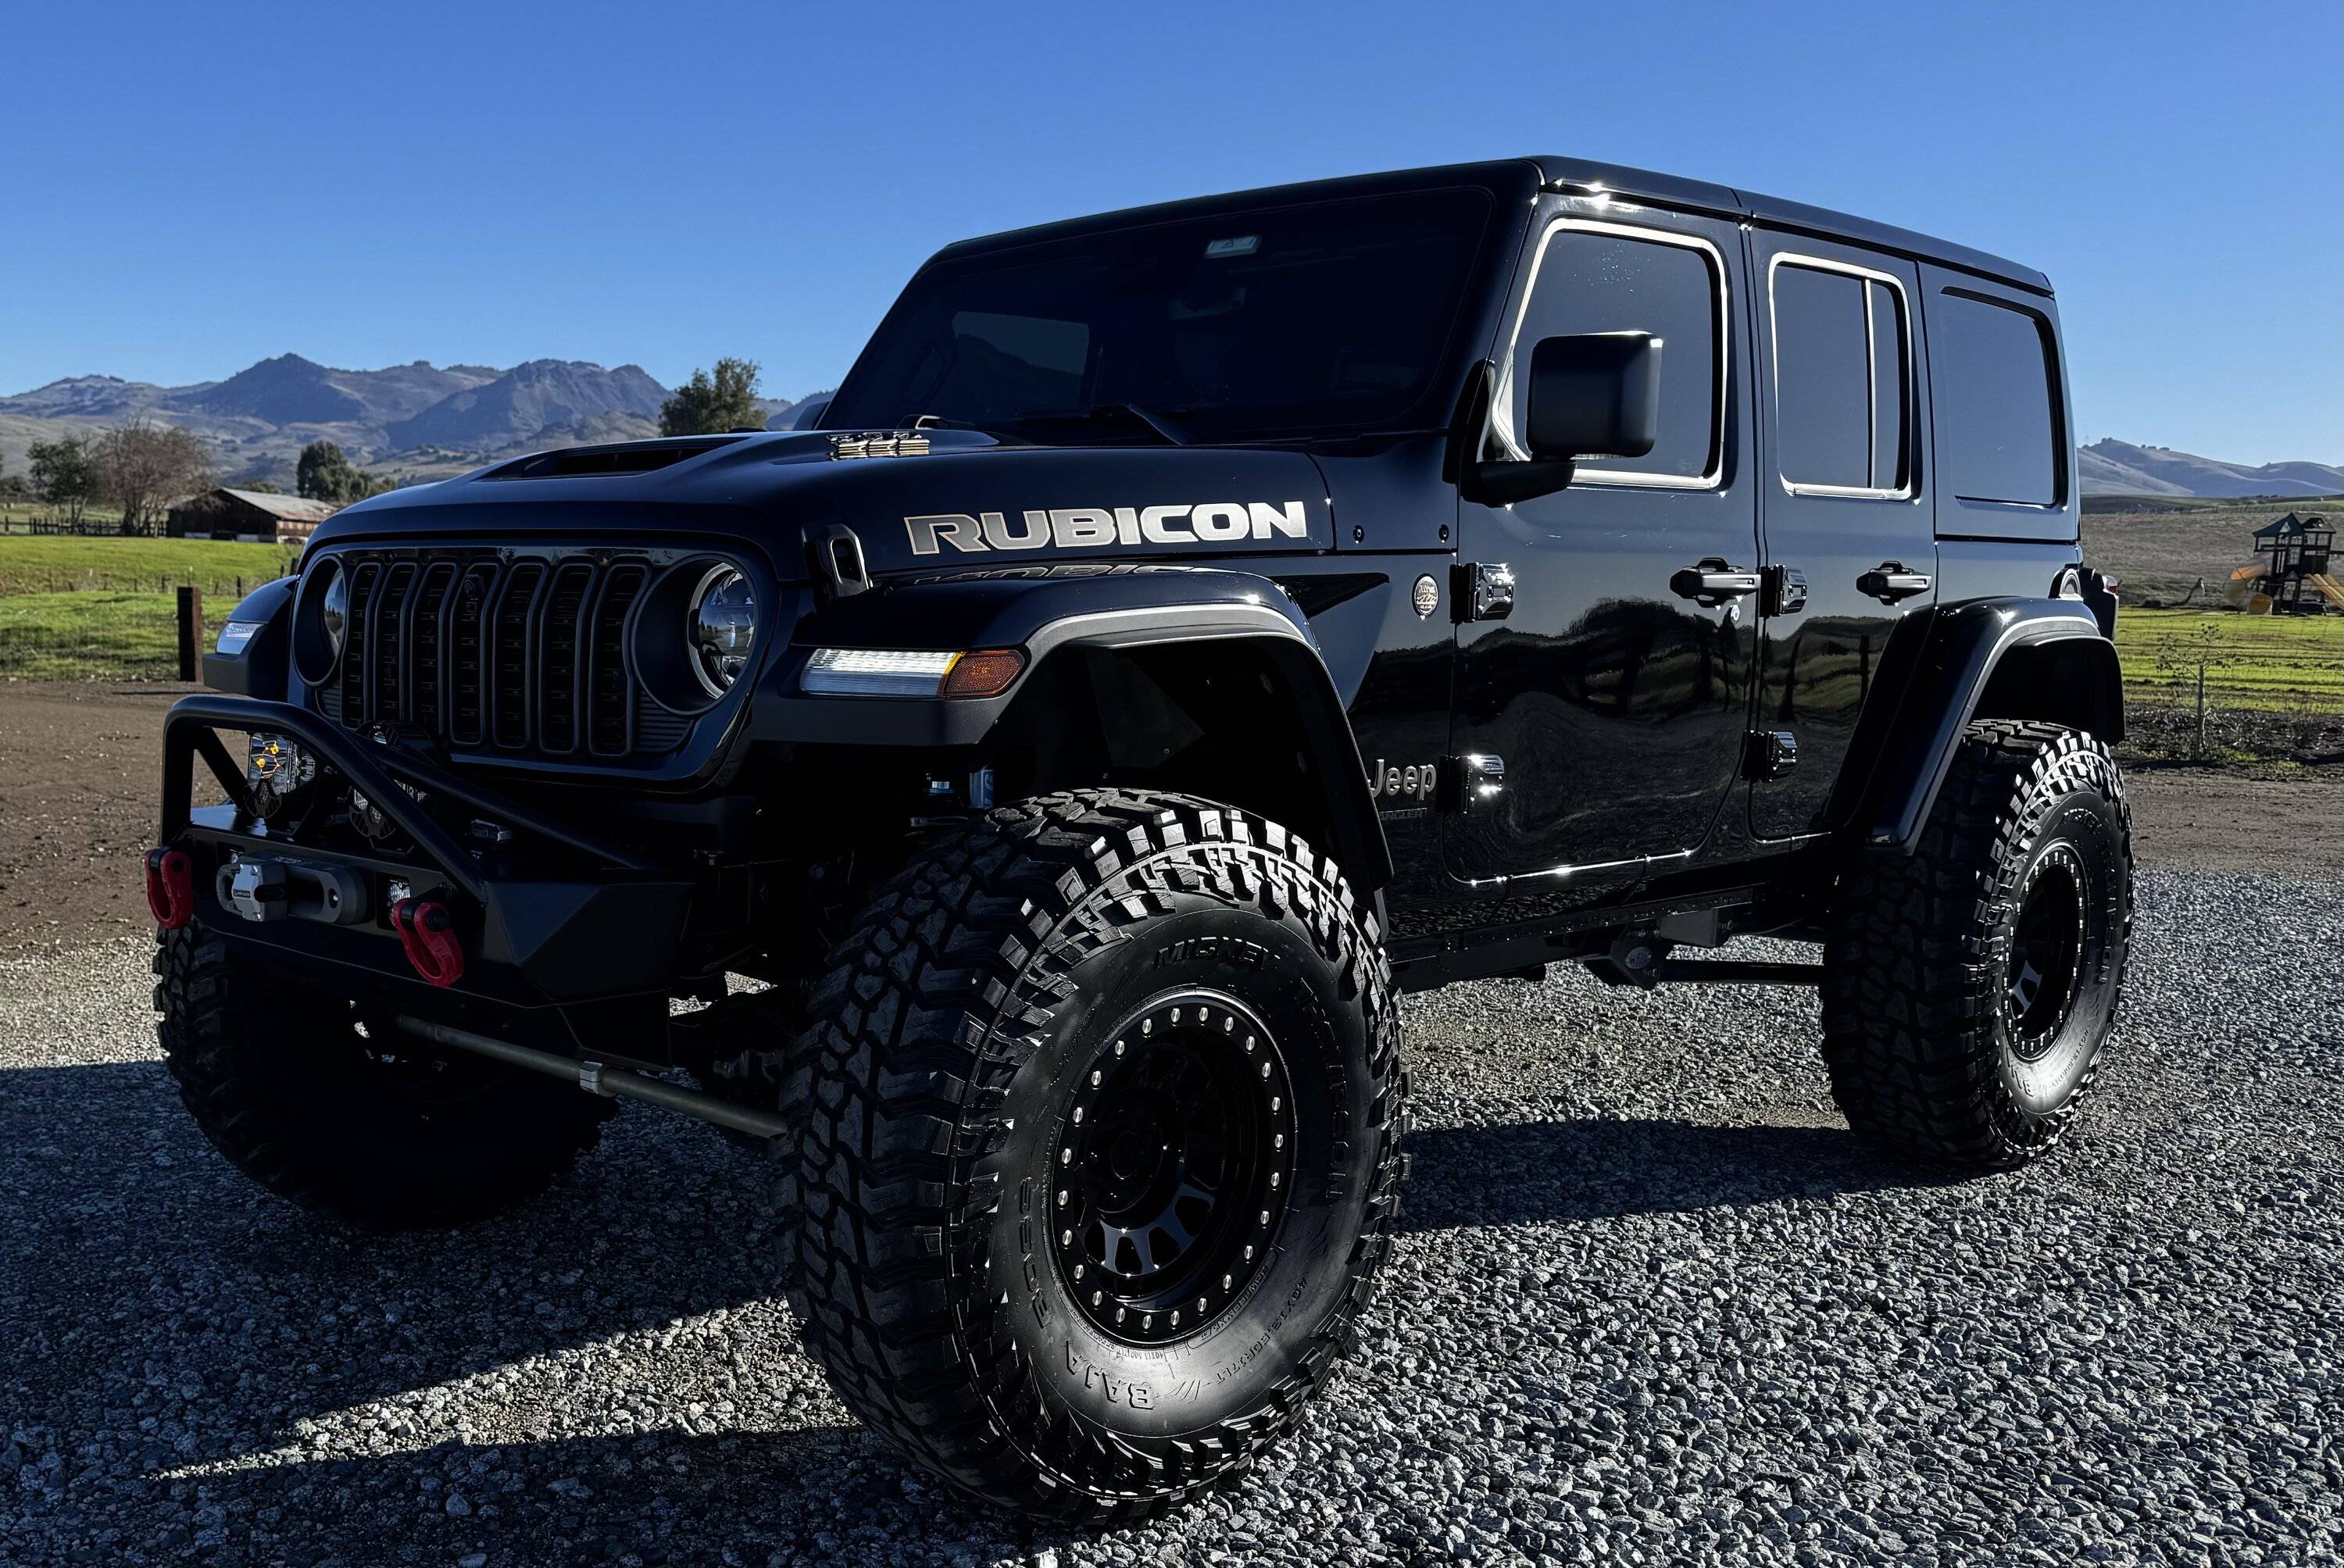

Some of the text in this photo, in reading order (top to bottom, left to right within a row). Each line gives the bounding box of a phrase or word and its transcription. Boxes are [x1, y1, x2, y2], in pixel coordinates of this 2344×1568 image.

[902, 500, 1308, 555] RUBICON
[1367, 758, 1438, 801] Jeep
[1017, 1176, 1050, 1330] BOSS
[1065, 1339, 1156, 1411] BAJA
